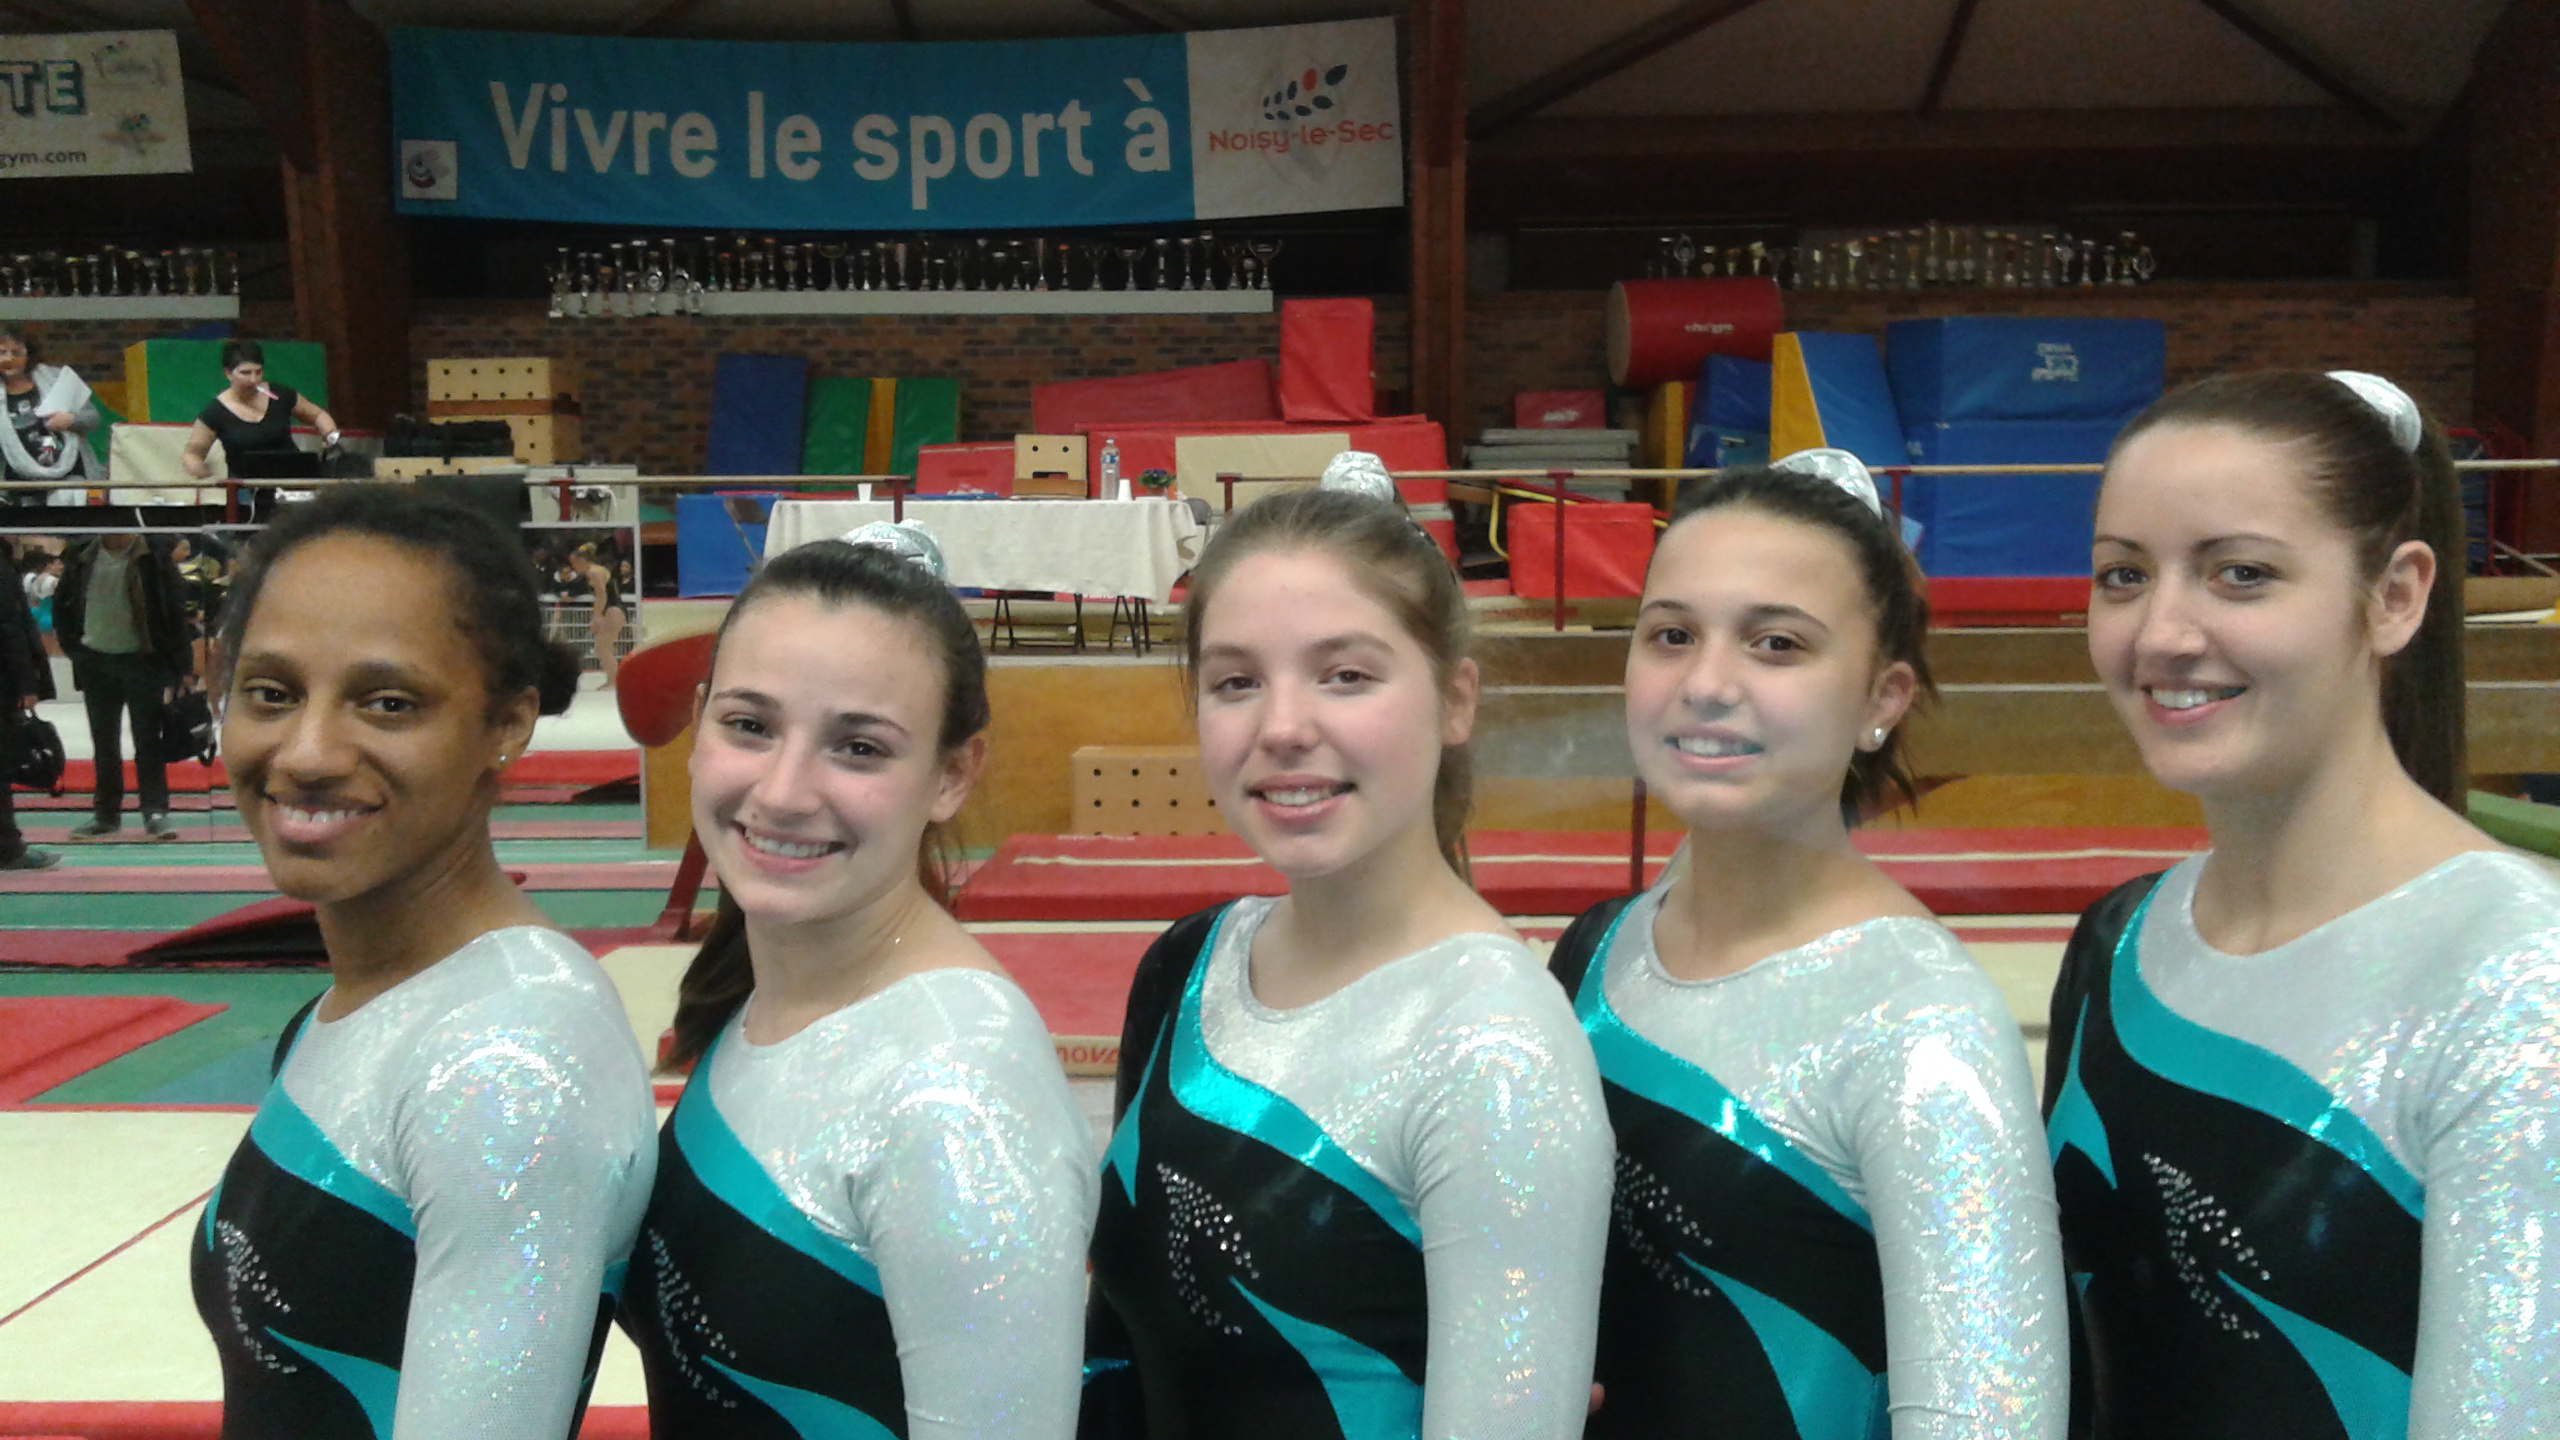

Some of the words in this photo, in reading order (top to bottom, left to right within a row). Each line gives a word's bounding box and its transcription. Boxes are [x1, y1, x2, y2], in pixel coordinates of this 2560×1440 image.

[489, 81, 719, 178] Vivre
[747, 91, 822, 181] le
[852, 99, 1094, 210] sport
[1123, 78, 1171, 172] à
[1208, 119, 1395, 153] Noisy-le-Sec
